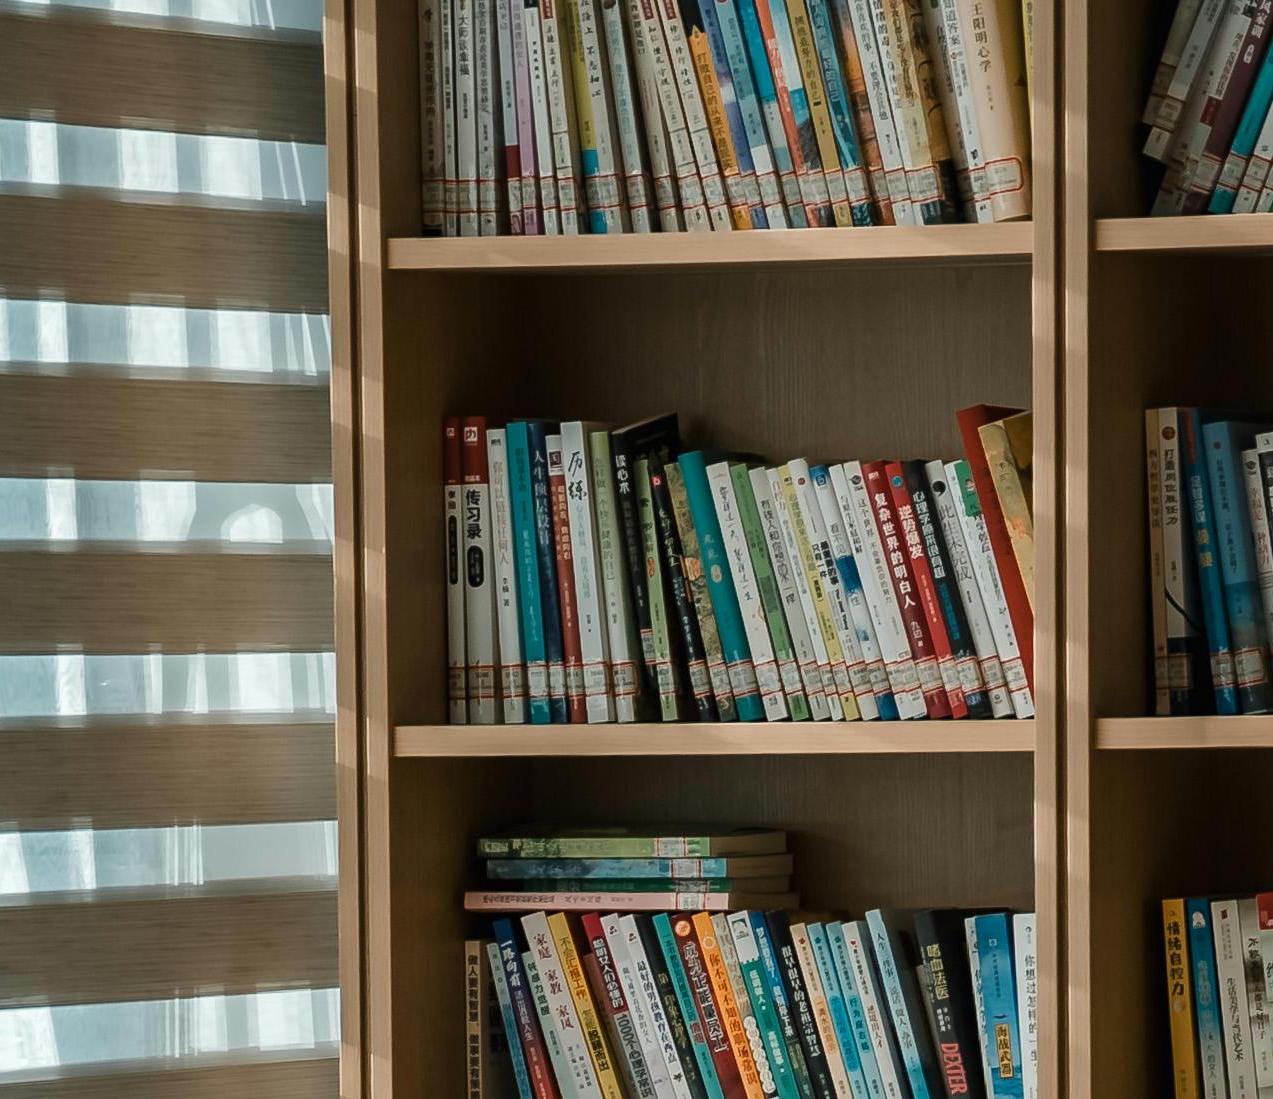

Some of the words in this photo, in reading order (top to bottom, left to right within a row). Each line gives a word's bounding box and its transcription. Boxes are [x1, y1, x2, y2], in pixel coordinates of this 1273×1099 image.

[971, 4, 994, 73] 王阳明心学
[567, 451, 588, 501] 历练
[1164, 448, 1179, 526] 打造岗位胜任力
[465, 489, 483, 540] 传习录
[898, 505, 924, 558] 逆势爆发
[937, 505, 973, 581] 此生未完成
[760, 499, 795, 606] 有钱人和你想的不一样
[874, 492, 916, 609] 复杂世界的明白人
[533, 932, 552, 960] 家庭
[926, 944, 950, 1000] 嗜血法医
[1166, 921, 1185, 997] 情绪自控力
[709, 954, 757, 1084] 你不可不知的职场常识
[940, 1043, 968, 1095] DEXTER
[995, 1026, 1014, 1076] 海战武器
